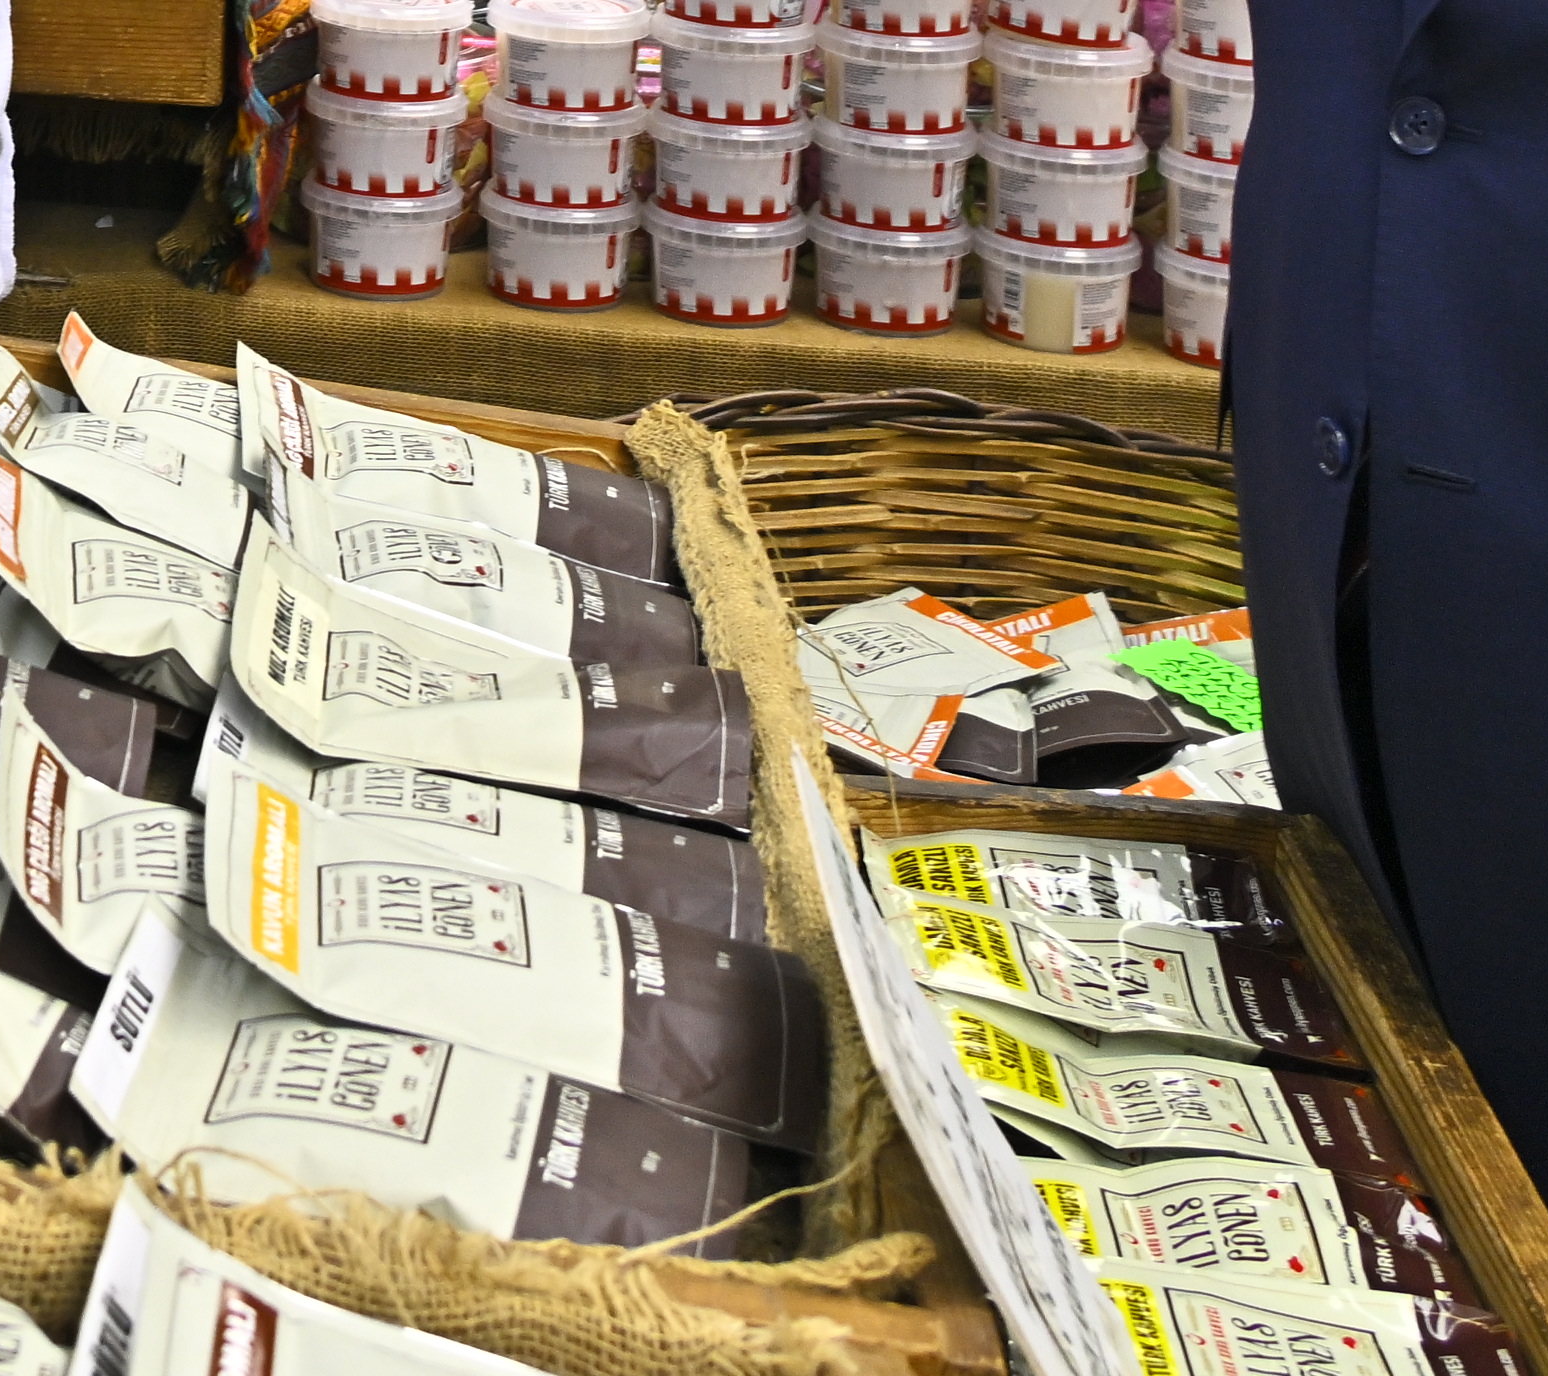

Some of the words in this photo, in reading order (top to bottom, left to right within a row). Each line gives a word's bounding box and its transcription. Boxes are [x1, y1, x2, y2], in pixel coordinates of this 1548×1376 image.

[543, 485, 570, 511] TÜRK
[271, 580, 297, 650] AROMALI
[578, 595, 606, 624] TÜRK
[936, 610, 1026, 656] ÇİKOLATALI
[296, 615, 314, 659] KAHVESİ
[858, 625, 915, 654] İLYAS
[267, 651, 289, 687] MUZ
[292, 658, 309, 686] TÜRK
[263, 796, 288, 887] AROMALI
[925, 848, 955, 896] SAKIZLI
[260, 892, 285, 956] KAVUN
[377, 873, 424, 934] İLYAS
[944, 909, 989, 961] SAKIZLI
[629, 957, 665, 996] TÜRK
[108, 968, 156, 1053] SÜTLÜ
[963, 1014, 994, 1062] DAMLA
[274, 1029, 339, 1105] İLYAS
[559, 1084, 592, 1146] KAHVESİ
[1110, 1077, 1165, 1126] İLYAS
[1303, 1092, 1328, 1124] KAHVESİ
[1314, 1120, 1336, 1146] TÜRK
[541, 1141, 578, 1189] TÜRK
[1119, 1285, 1164, 1341] KAHVESİ
[1144, 1338, 1179, 1376] TÜRK
